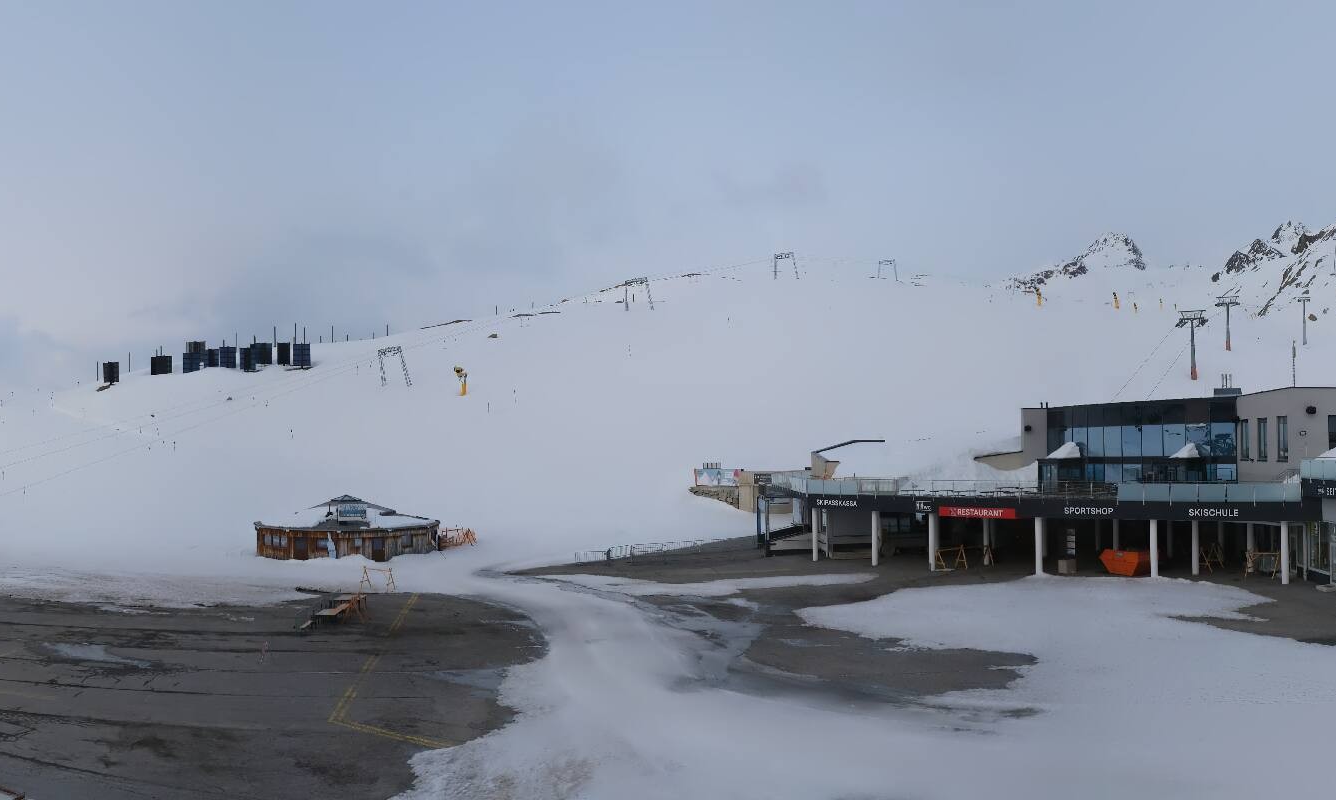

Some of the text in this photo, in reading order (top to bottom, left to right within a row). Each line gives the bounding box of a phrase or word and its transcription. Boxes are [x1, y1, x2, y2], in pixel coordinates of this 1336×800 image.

[957, 508, 1004, 517] RESTAURANT
[1064, 507, 1114, 515] SPORTSHOP
[1188, 508, 1239, 517] SKISCHULE
